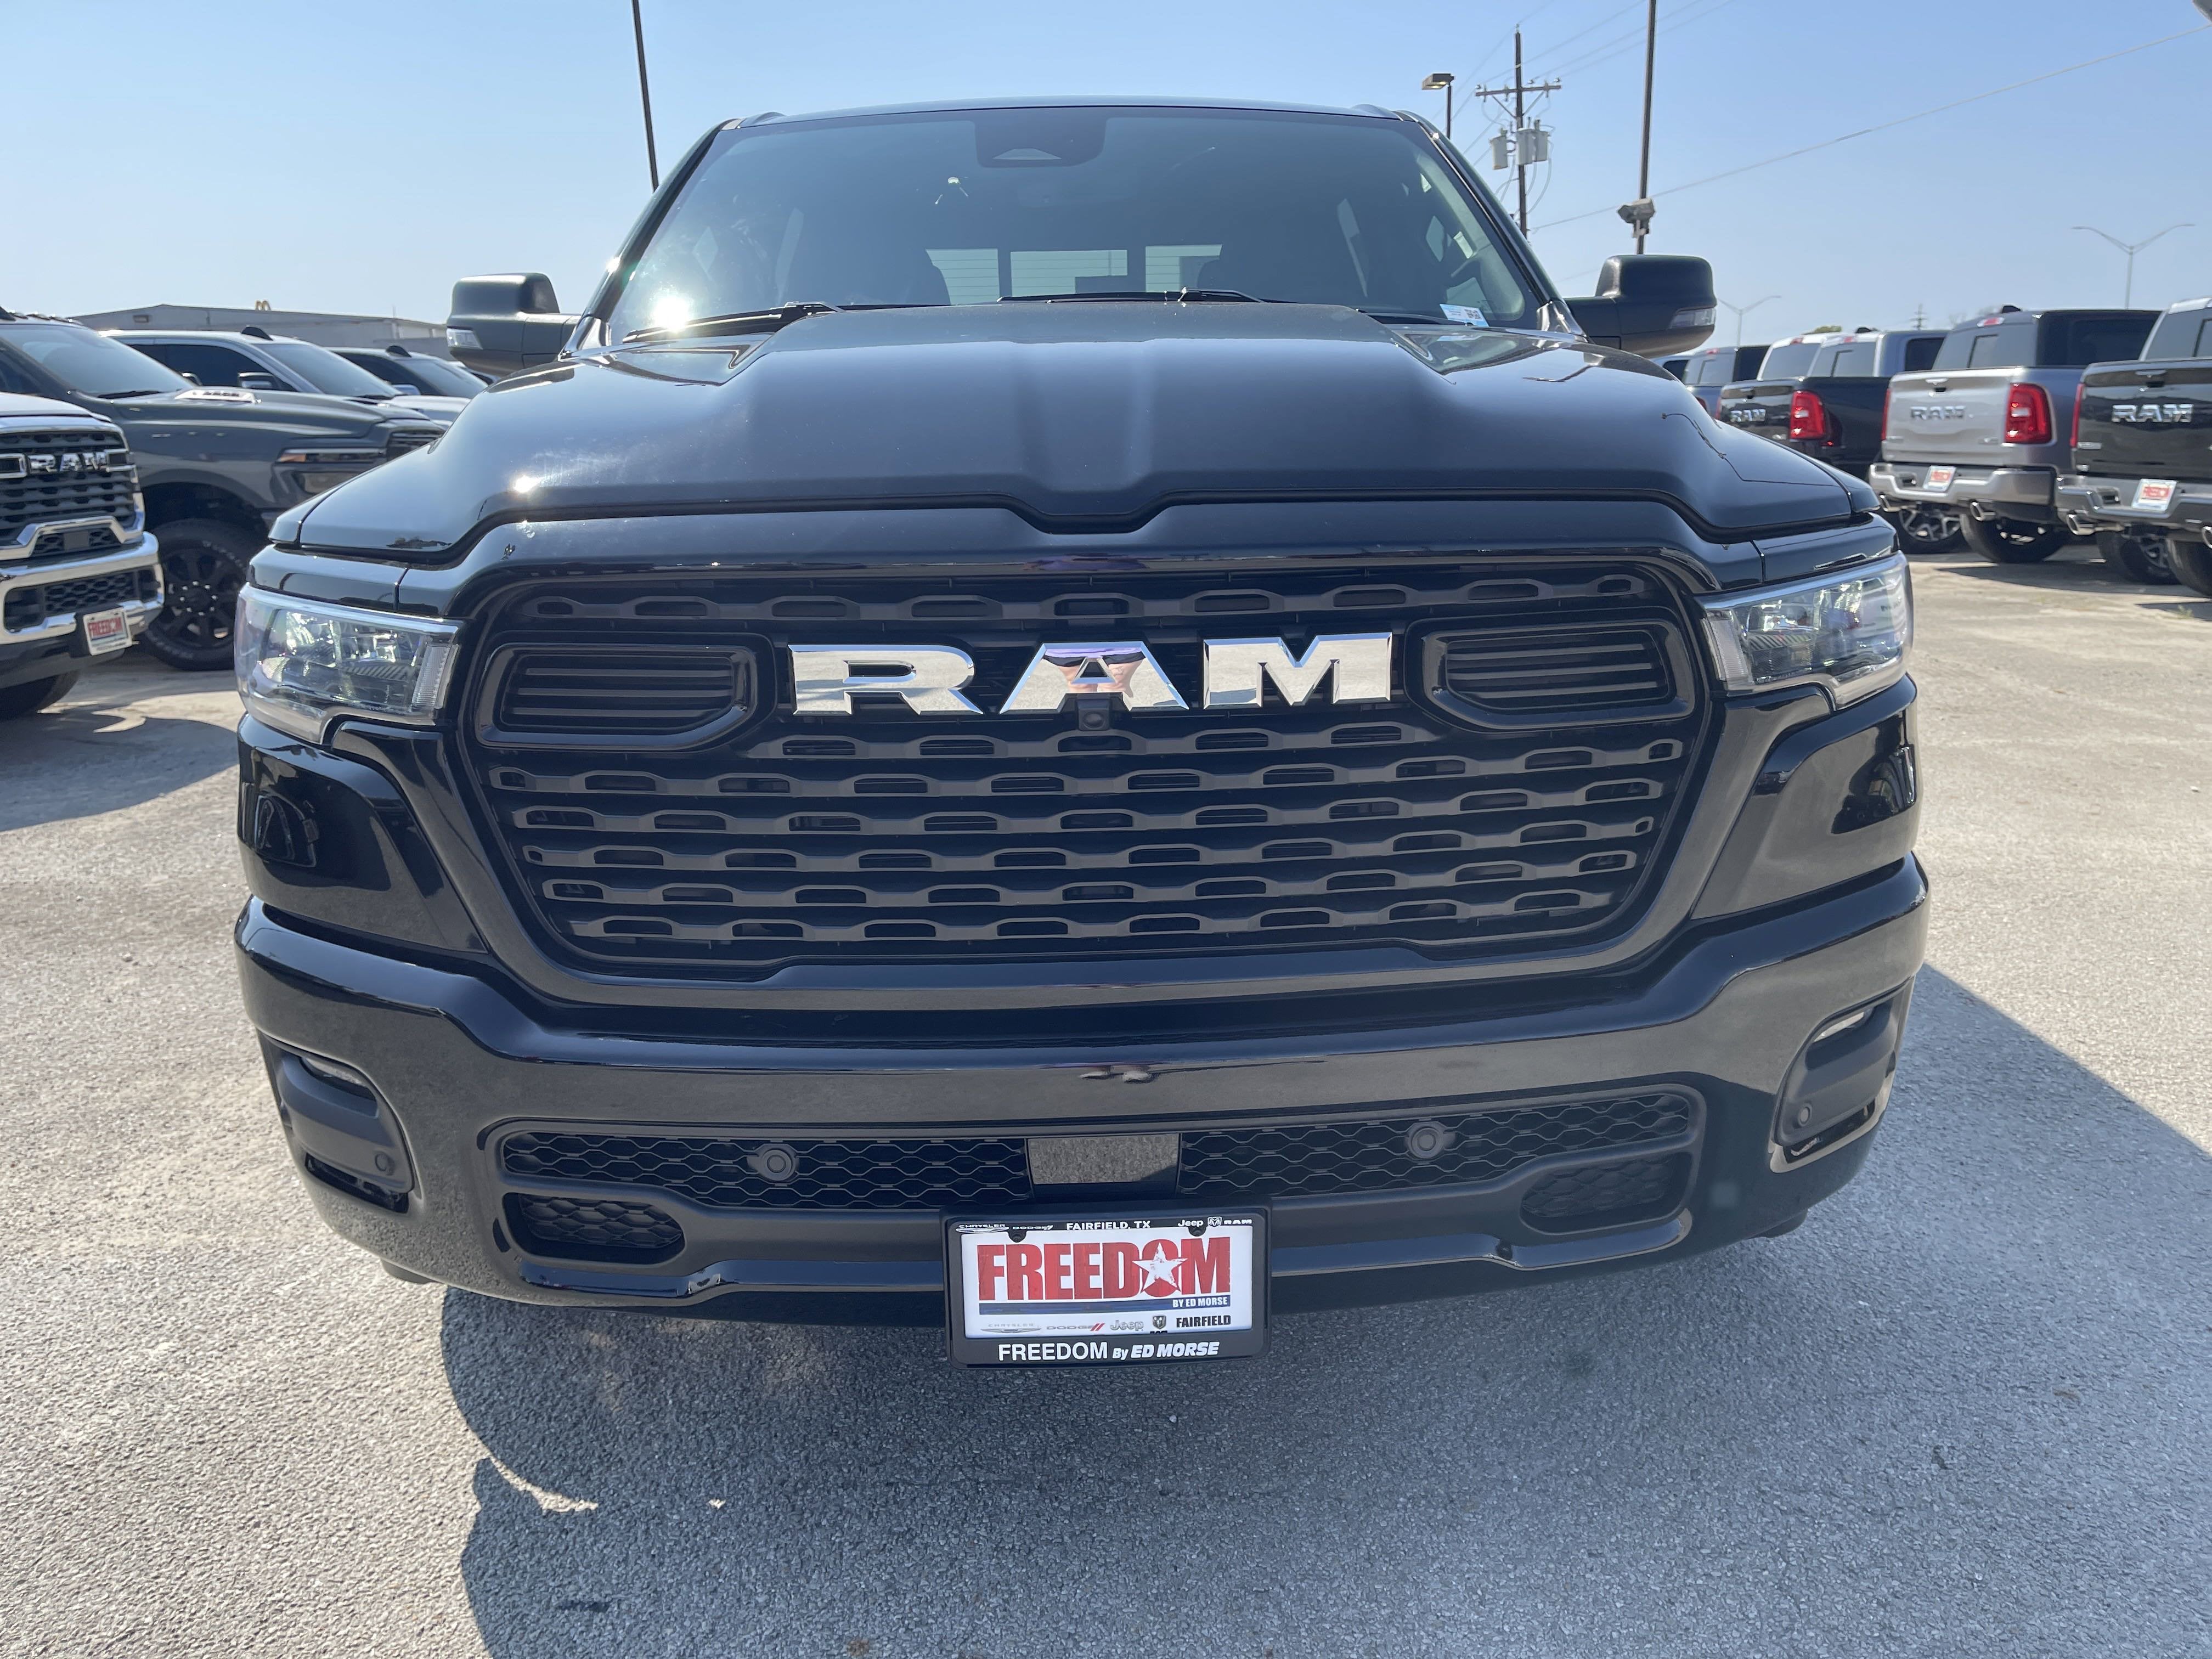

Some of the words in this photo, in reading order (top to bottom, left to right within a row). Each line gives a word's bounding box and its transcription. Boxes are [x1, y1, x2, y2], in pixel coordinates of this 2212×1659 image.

[1730, 409, 1767, 422] RAM
[1910, 405, 1966, 420] RAM
[2112, 404, 2194, 422] RAM
[28, 452, 108, 473] RAM
[787, 632, 1393, 715] RAM
[1066, 1221, 1131, 1231] FAIRFIELD,
[1133, 1220, 1150, 1229] TX
[977, 1237, 1231, 1301] FREEDOM
[1172, 1299, 1183, 1308] BY
[1186, 1298, 1196, 1307] ED
[1198, 1296, 1228, 1306] MORSE
[1110, 1320, 1144, 1331] Jeep
[1176, 1315, 1231, 1328] FAIRFIELD
[998, 1341, 1108, 1361] FREEDOM
[1112, 1347, 1129, 1361] By
[1131, 1344, 1155, 1358] ED
[1156, 1341, 1220, 1358] MORSE
